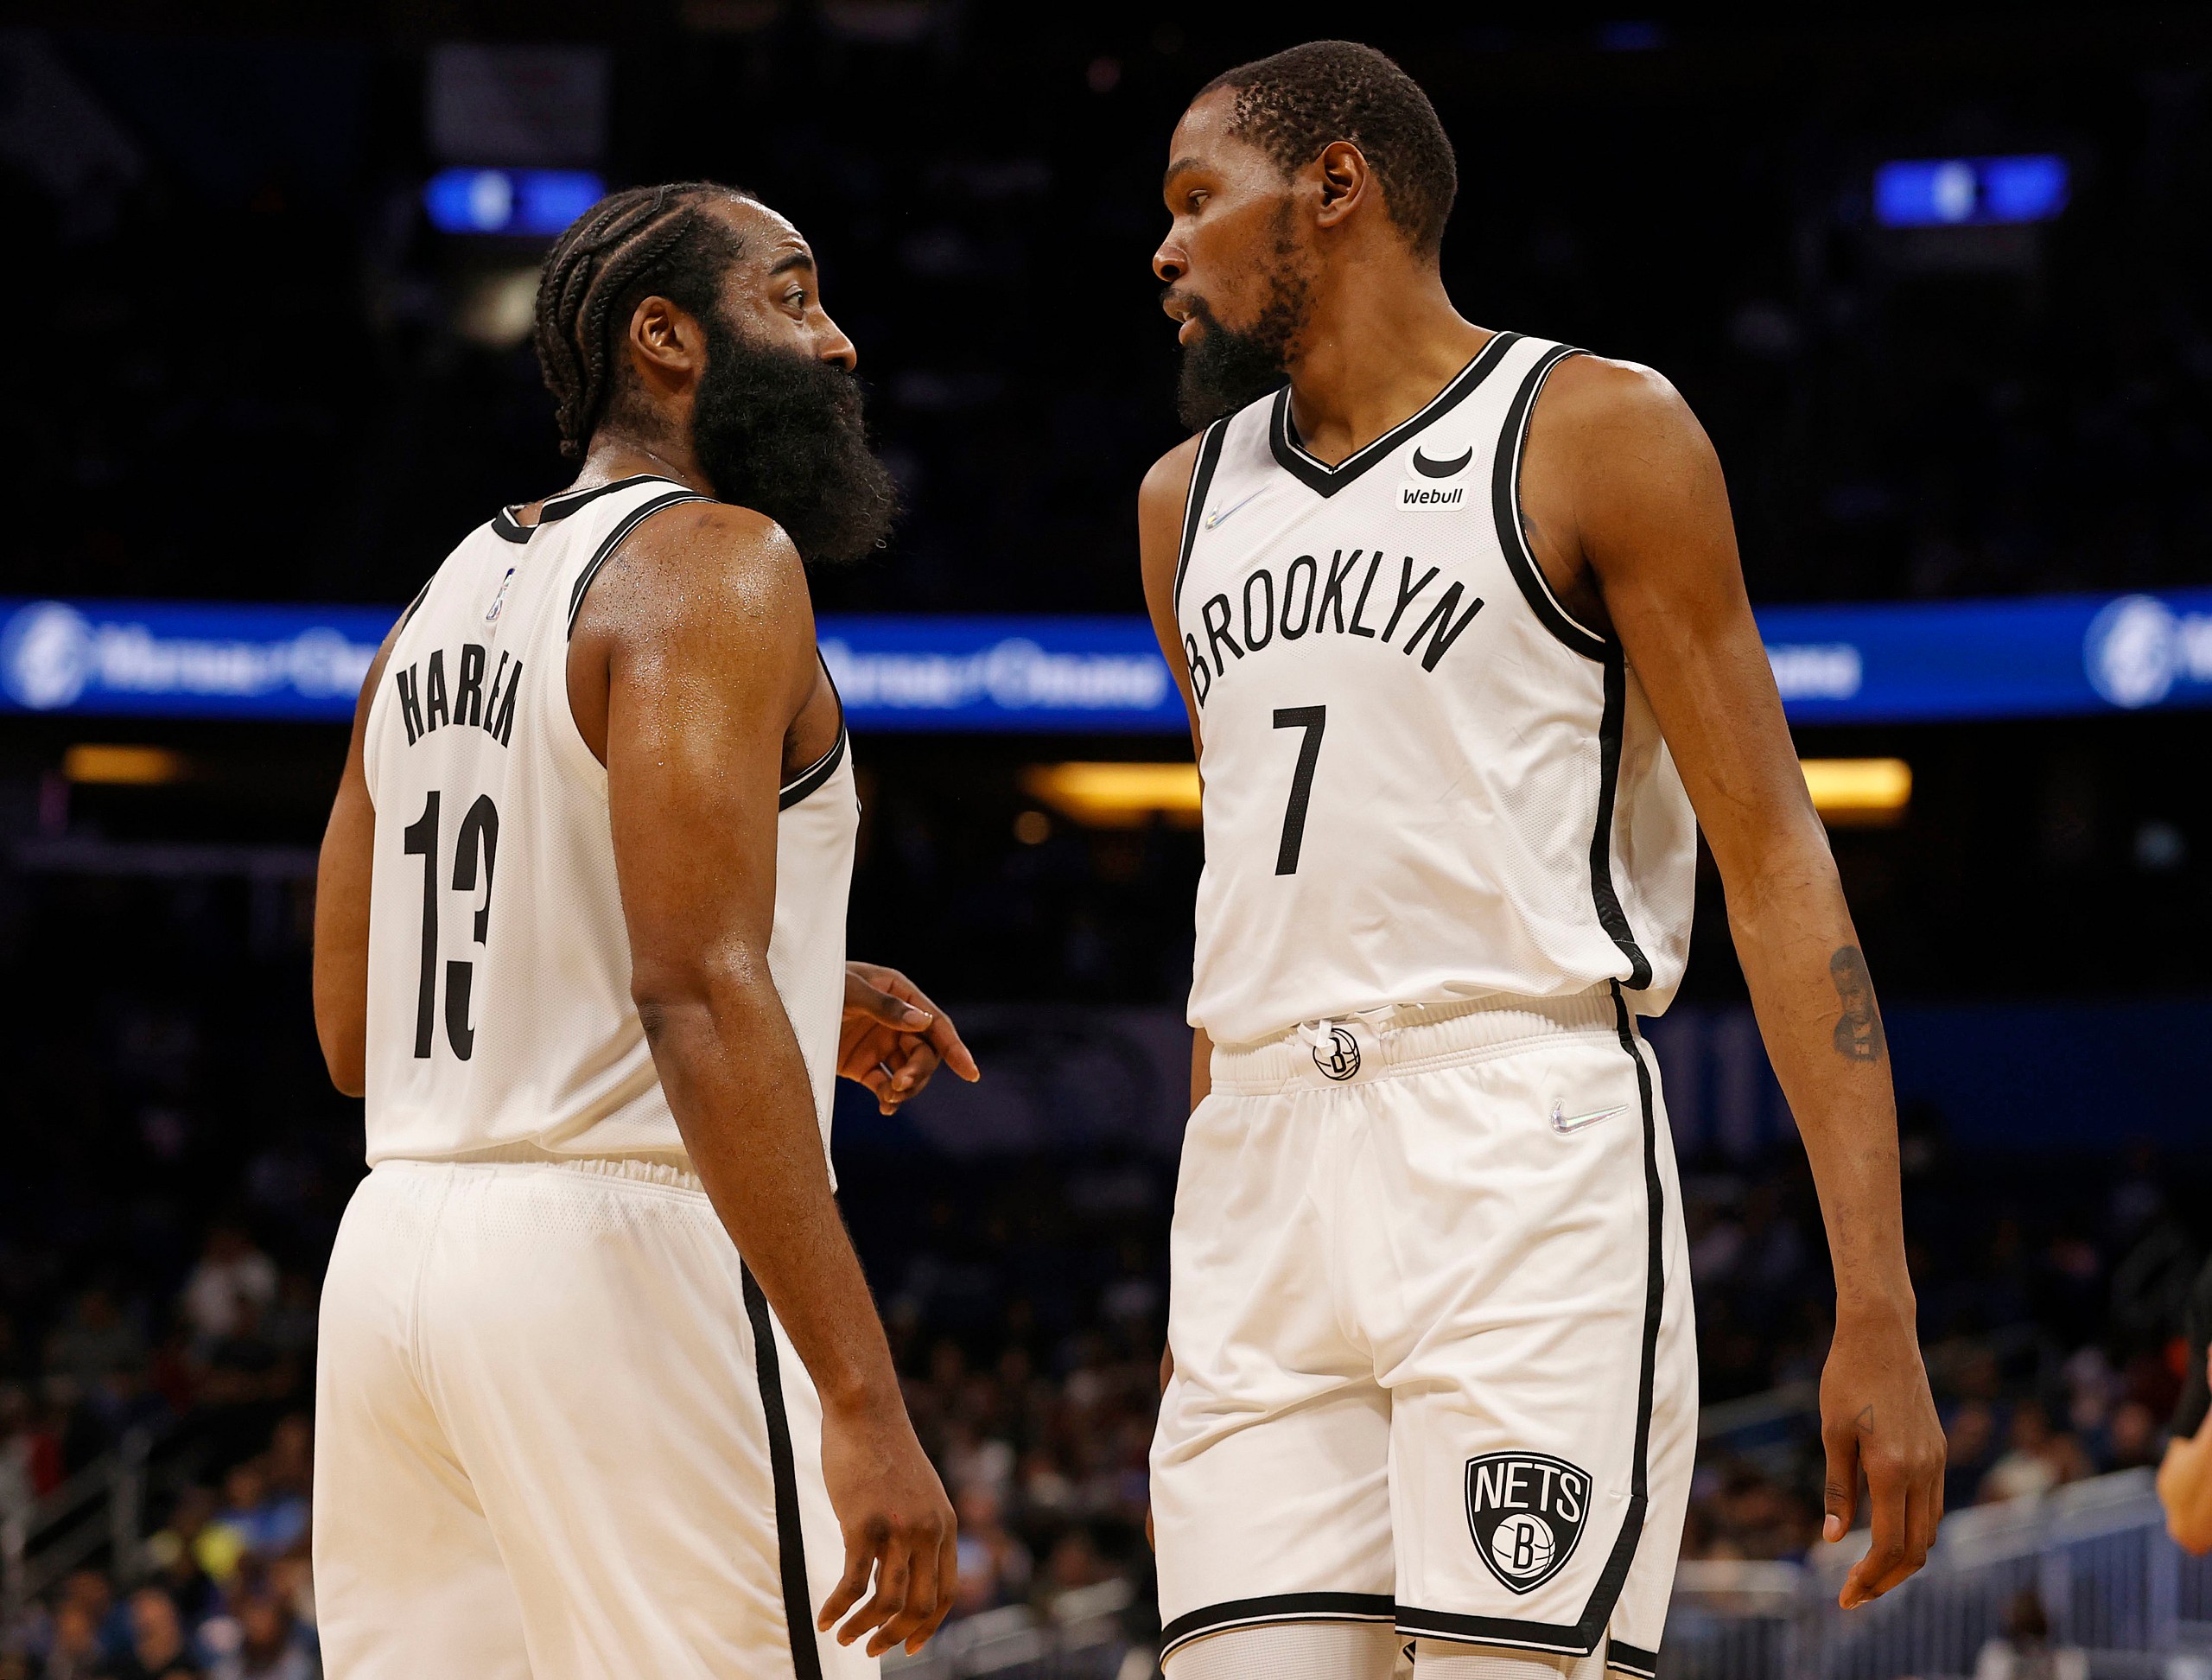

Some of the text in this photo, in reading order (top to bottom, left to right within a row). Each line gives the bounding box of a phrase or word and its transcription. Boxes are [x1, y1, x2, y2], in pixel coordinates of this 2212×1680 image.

[1403, 488, 1463, 504] Webull
[1185, 550, 1484, 710] BROOKLYN
[1273, 704, 1326, 875] 7
[404, 790, 499, 1061] 13
[1474, 1461, 1581, 1523] NETS
[1513, 1523, 1534, 1569] B
